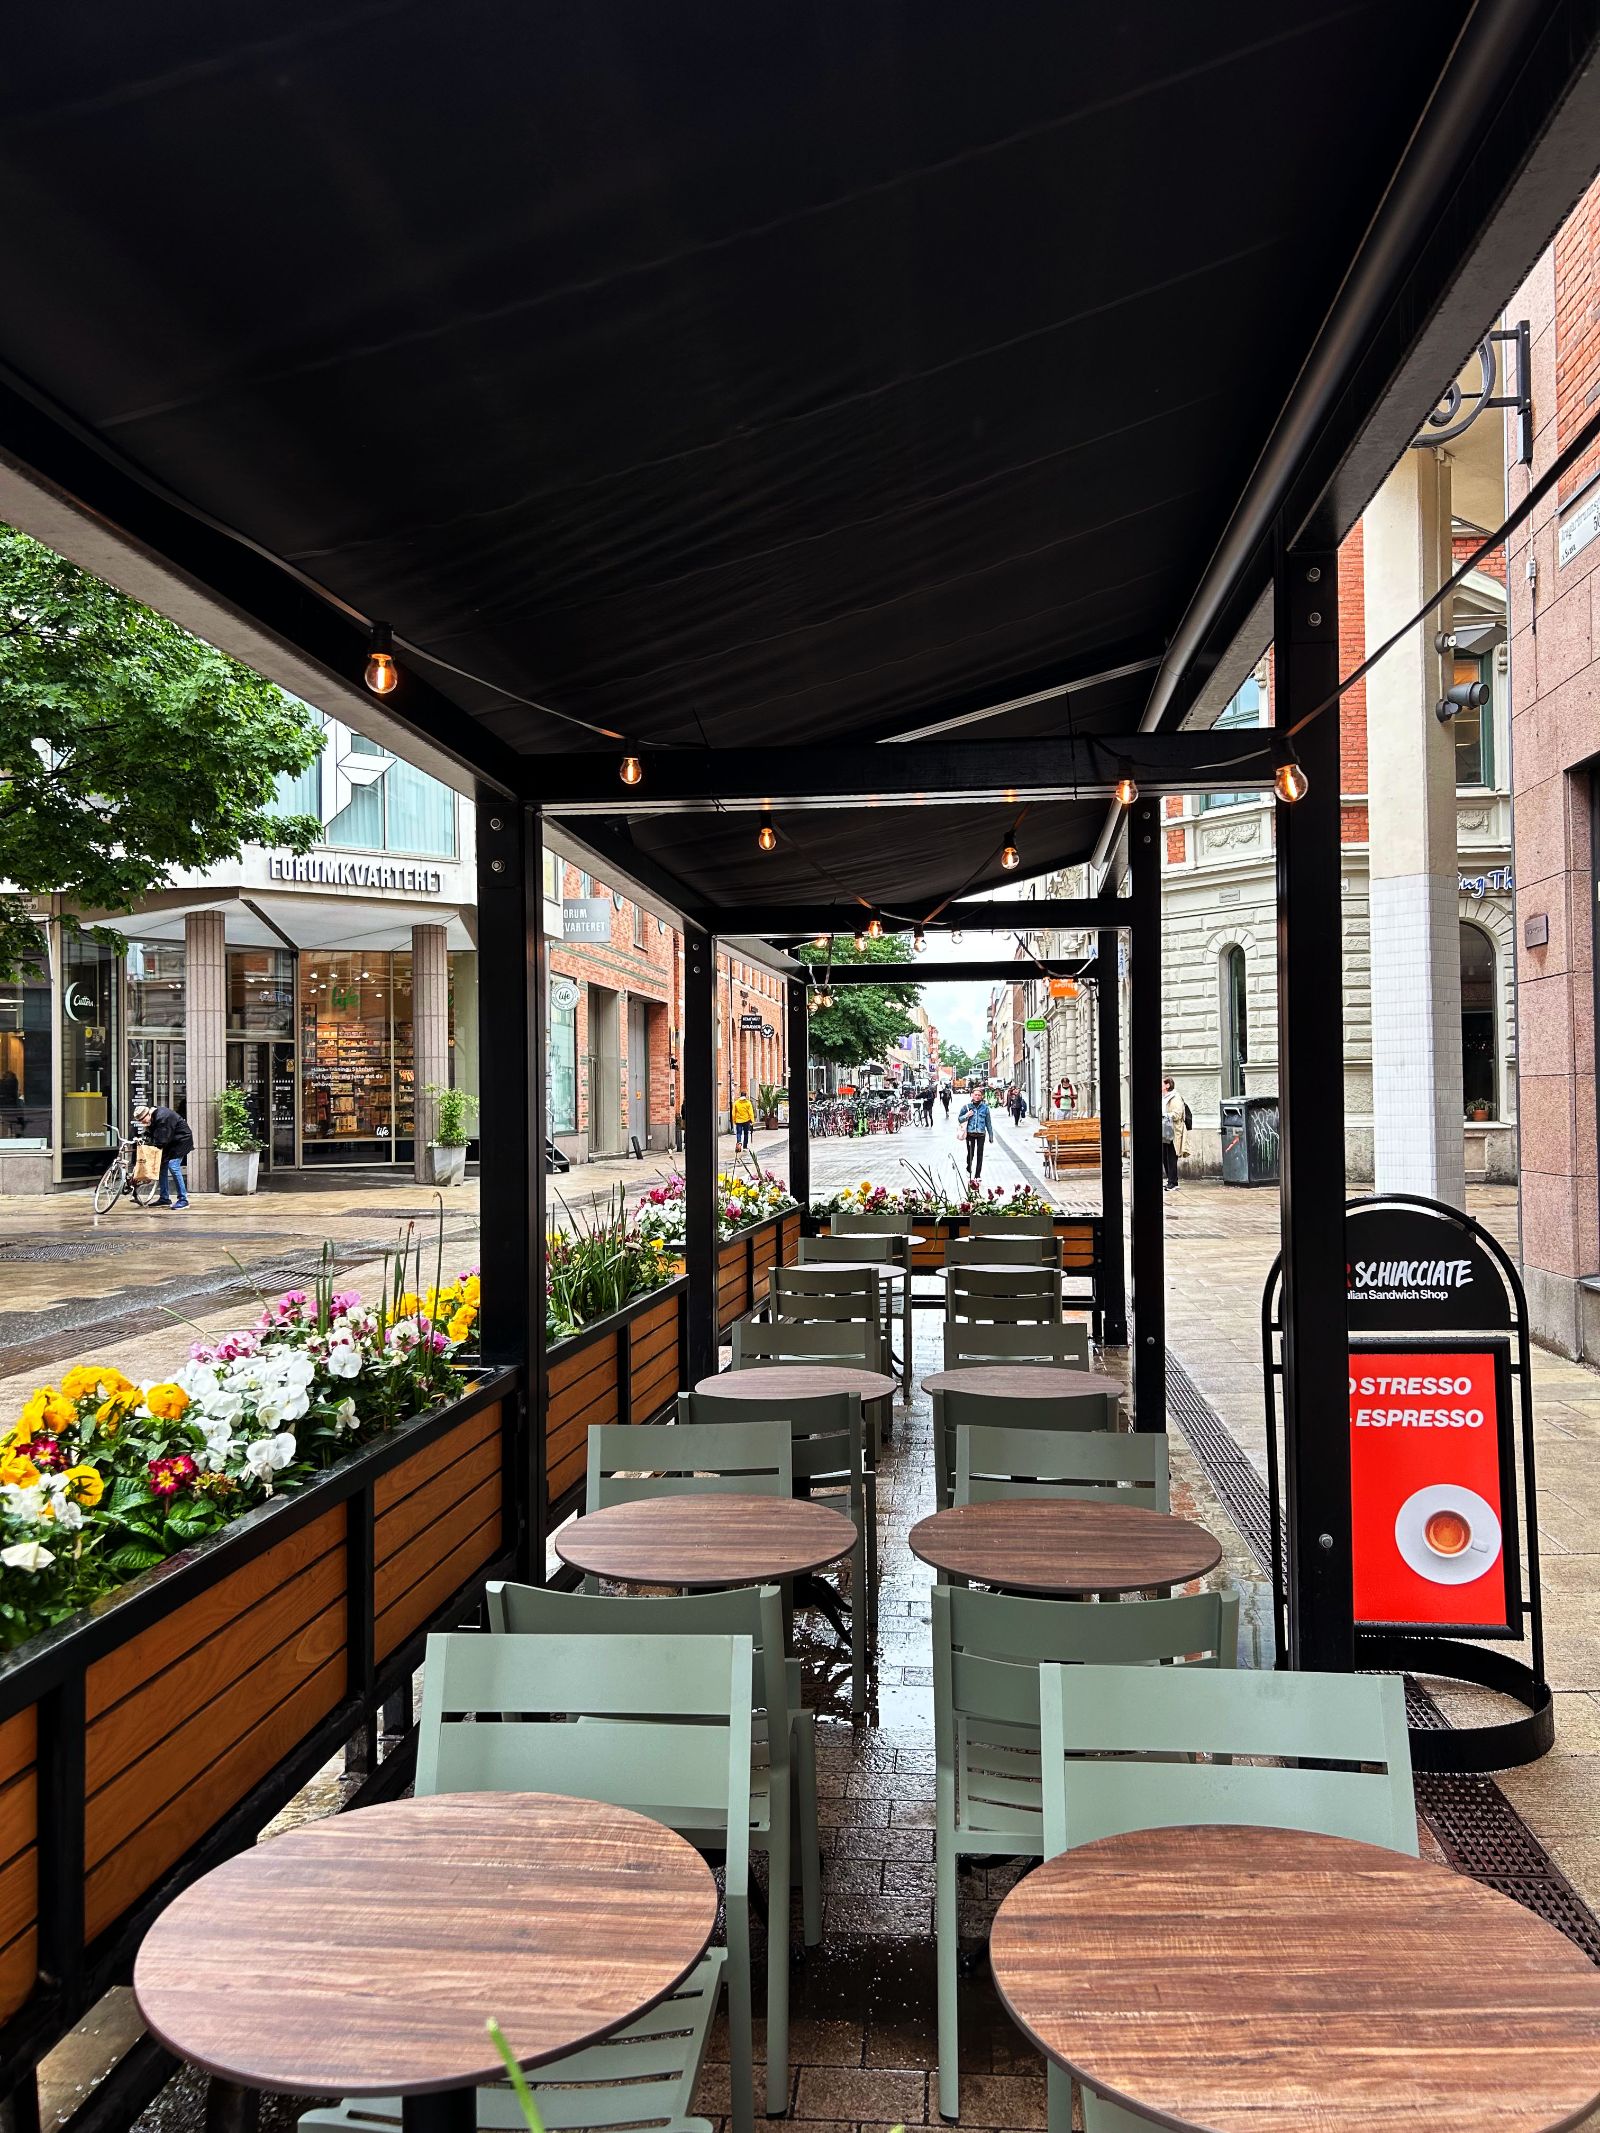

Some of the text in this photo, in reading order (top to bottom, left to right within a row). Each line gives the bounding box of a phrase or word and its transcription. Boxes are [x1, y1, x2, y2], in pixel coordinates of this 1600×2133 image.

[269, 856, 446, 892] FORUMKVARTERET
[558, 990, 570, 1001] life
[376, 1126, 389, 1137] life
[1355, 1260, 1474, 1288] SCHIACCIATE
[1368, 1289, 1419, 1300] Sandwich
[1420, 1289, 1448, 1301] Shop
[1359, 1376, 1472, 1395] STRESSO
[1355, 1408, 1484, 1428] ESPRESSO
